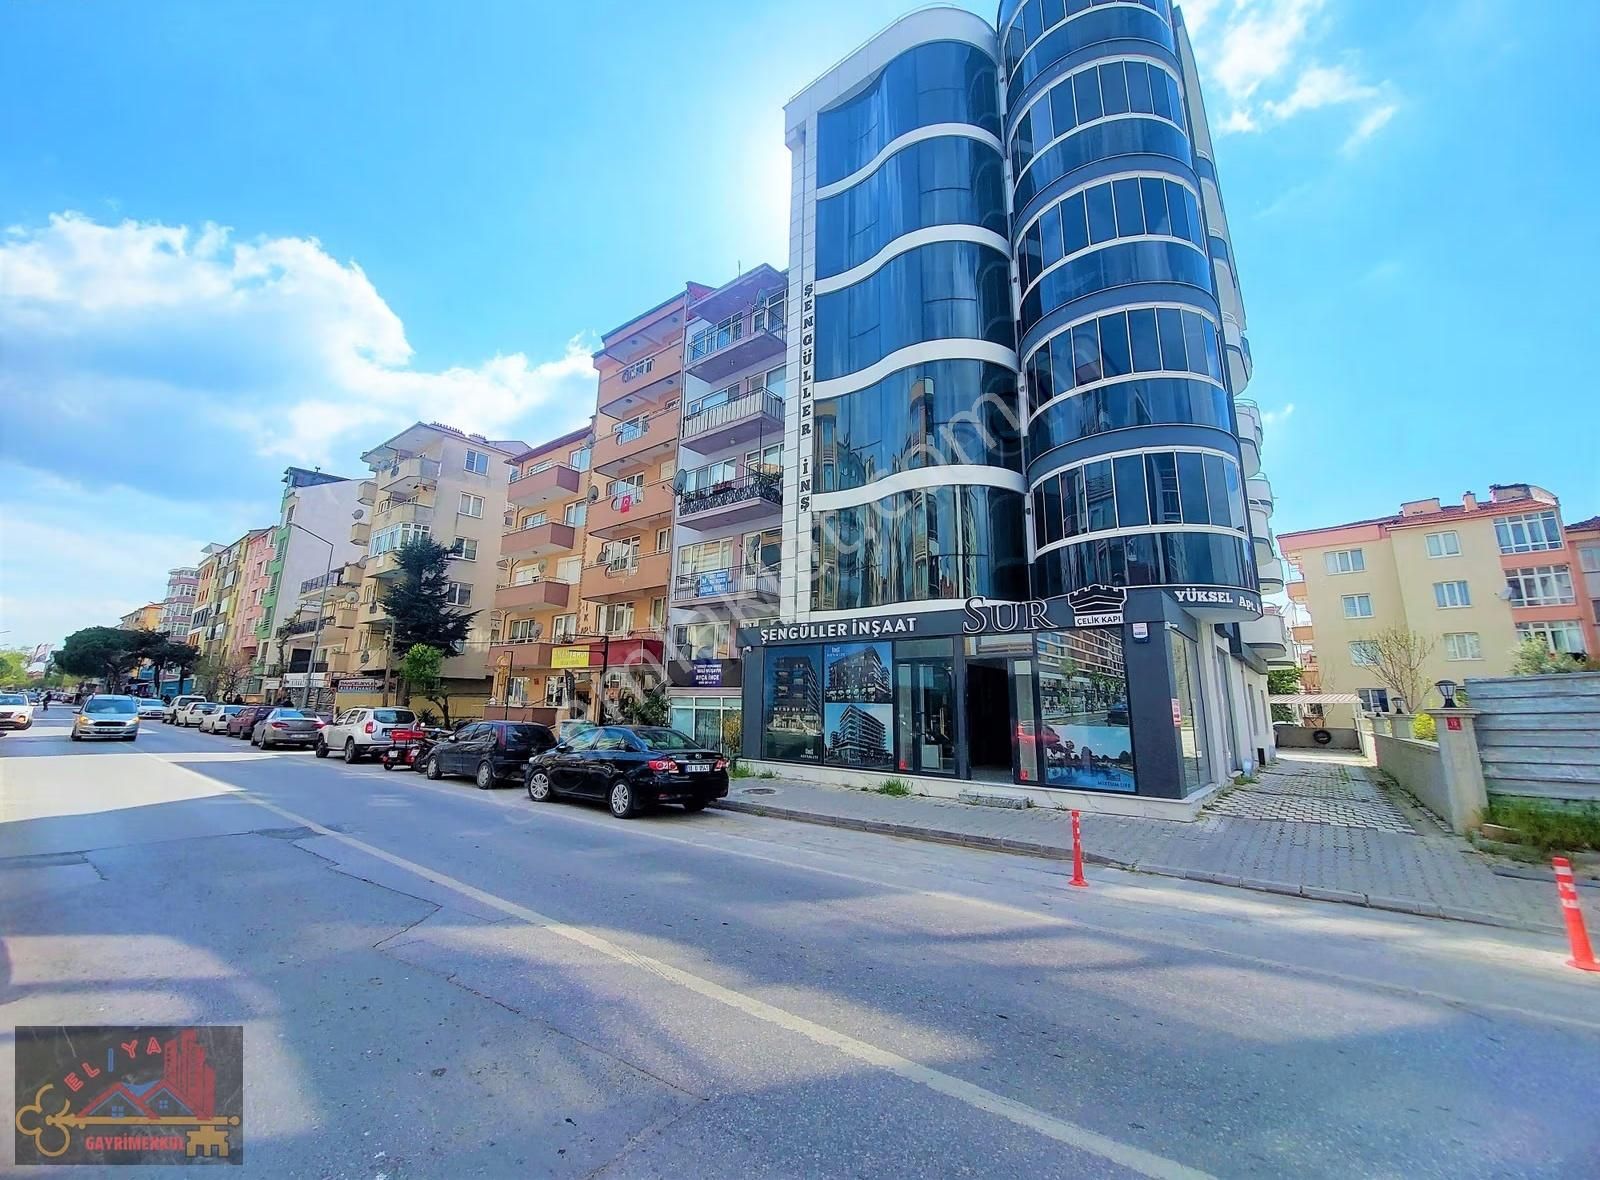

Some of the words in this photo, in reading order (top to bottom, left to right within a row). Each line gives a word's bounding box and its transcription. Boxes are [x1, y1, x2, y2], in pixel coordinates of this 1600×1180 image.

[801, 283, 815, 436] ŞENGÜLLER
[799, 458, 812, 512] İNŞ
[1174, 588, 1234, 604] YÜKSEL
[760, 623, 847, 644] ŞENGÜLLER
[852, 617, 917, 638] İNŞAAT
[962, 595, 1058, 634] SUR
[1076, 616, 1100, 626] ÇELİK
[1101, 615, 1121, 624] KAPI
